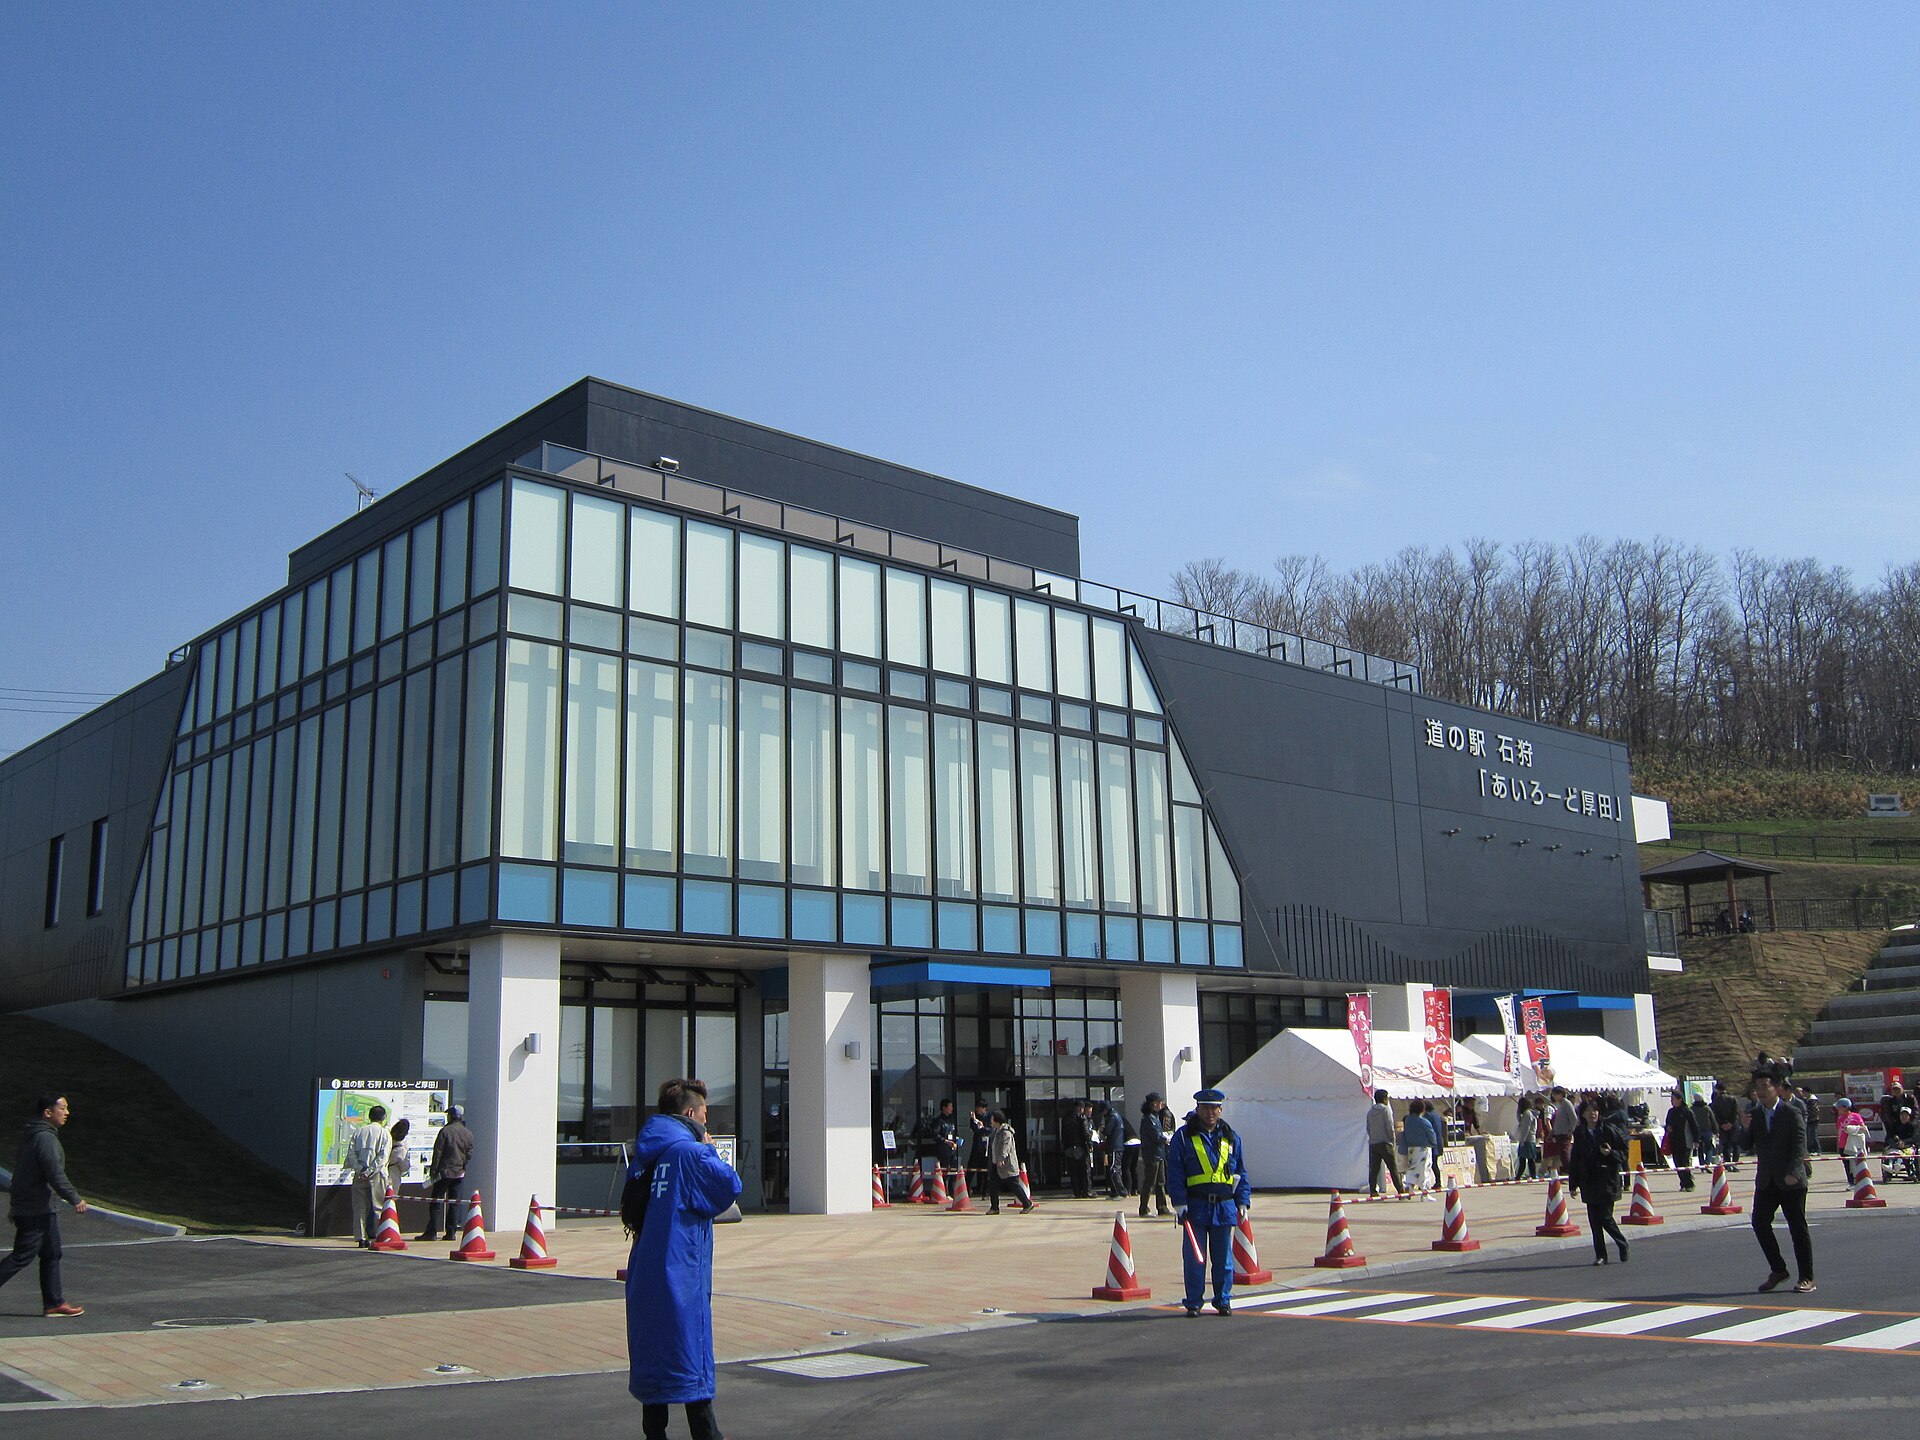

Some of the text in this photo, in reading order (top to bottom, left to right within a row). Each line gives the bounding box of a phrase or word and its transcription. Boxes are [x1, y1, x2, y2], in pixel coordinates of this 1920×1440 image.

[1425, 718, 1533, 768] 道の駅 石狩
[1478, 768, 1622, 822] 「あいろーど厚田」
